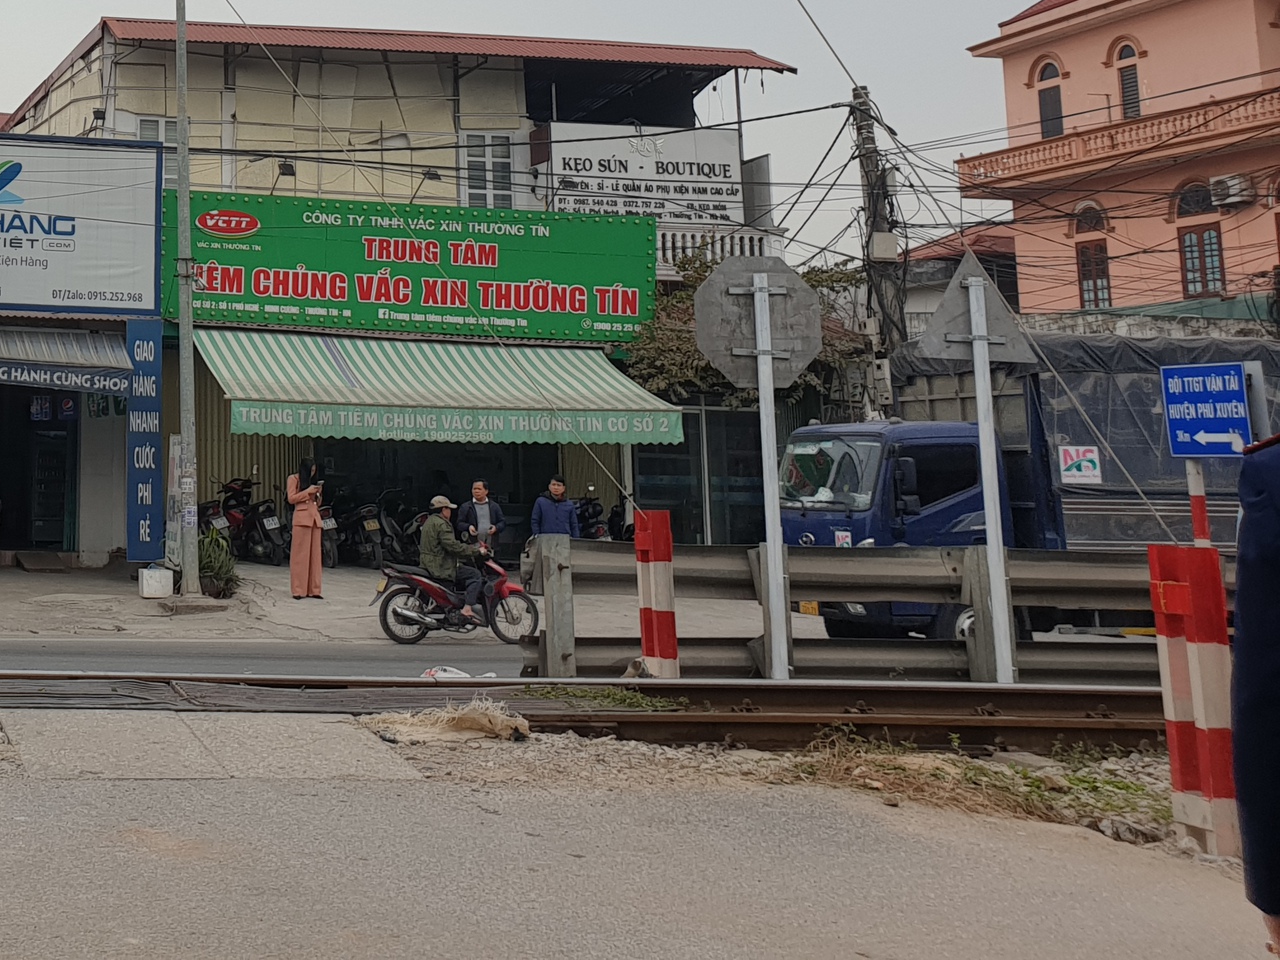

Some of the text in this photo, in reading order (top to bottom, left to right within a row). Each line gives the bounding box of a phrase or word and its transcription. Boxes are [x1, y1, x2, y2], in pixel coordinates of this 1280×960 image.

[561, 154, 733, 179] KẸO SÚN BOUTIQUE
[622, 181, 642, 193] QUẦN
[644, 182, 654, 193] ÁO
[656, 184, 670, 195] PHỤ
[673, 183, 690, 196] KIỆN
[692, 186, 708, 195] NAM
[710, 187, 724, 196] CAO
[725, 184, 740, 197] CẤP
[205, 216, 251, 229] VCTT
[302, 210, 550, 237] CÔNG TY TNHH VẮC XIN THƯỜNG TÍN
[222, 242, 250, 251] THƯỜNG
[362, 236, 499, 268] TRUNG TÂM
[20, 255, 48, 270] Hàng
[52, 289, 143, 302] ĐT/Zalo: 0915.252.968
[192, 259, 639, 316] IÊM CHỦNG VẮC XIN THƯỜNG TÍN
[390, 311, 410, 322] Trung
[612, 323, 622, 331] 25
[623, 323, 633, 332] 25
[133, 340, 155, 362] GIAO
[10, 363, 50, 383] HÀNH
[53, 368, 91, 388] CÙNG
[93, 377, 129, 392] SHOP
[132, 375, 157, 397] HÀNG
[1168, 370, 1239, 395] ĐỘI TTGT VẬN TẢI
[239, 407, 294, 424] TRUNG
[297, 406, 333, 427] TÂM
[337, 407, 378, 428] TIÊM
[382, 409, 438, 430] CHỦNG
[441, 409, 473, 431] VẮC
[477, 415, 505, 431] XIN
[508, 412, 572, 432] THƯỜNG
[607, 416, 630, 432] CƠ
[632, 413, 655, 433] SỞ
[659, 417, 669, 433] 2
[1168, 399, 1246, 421] HUYỆN PHÚ XUYÊN
[129, 412, 159, 434] NHANH
[379, 430, 494, 441] Hotline: 1900252560
[133, 446, 156, 470] CƯỚC
[137, 481, 153, 506] PHÍ
[139, 514, 151, 543] RẺ
